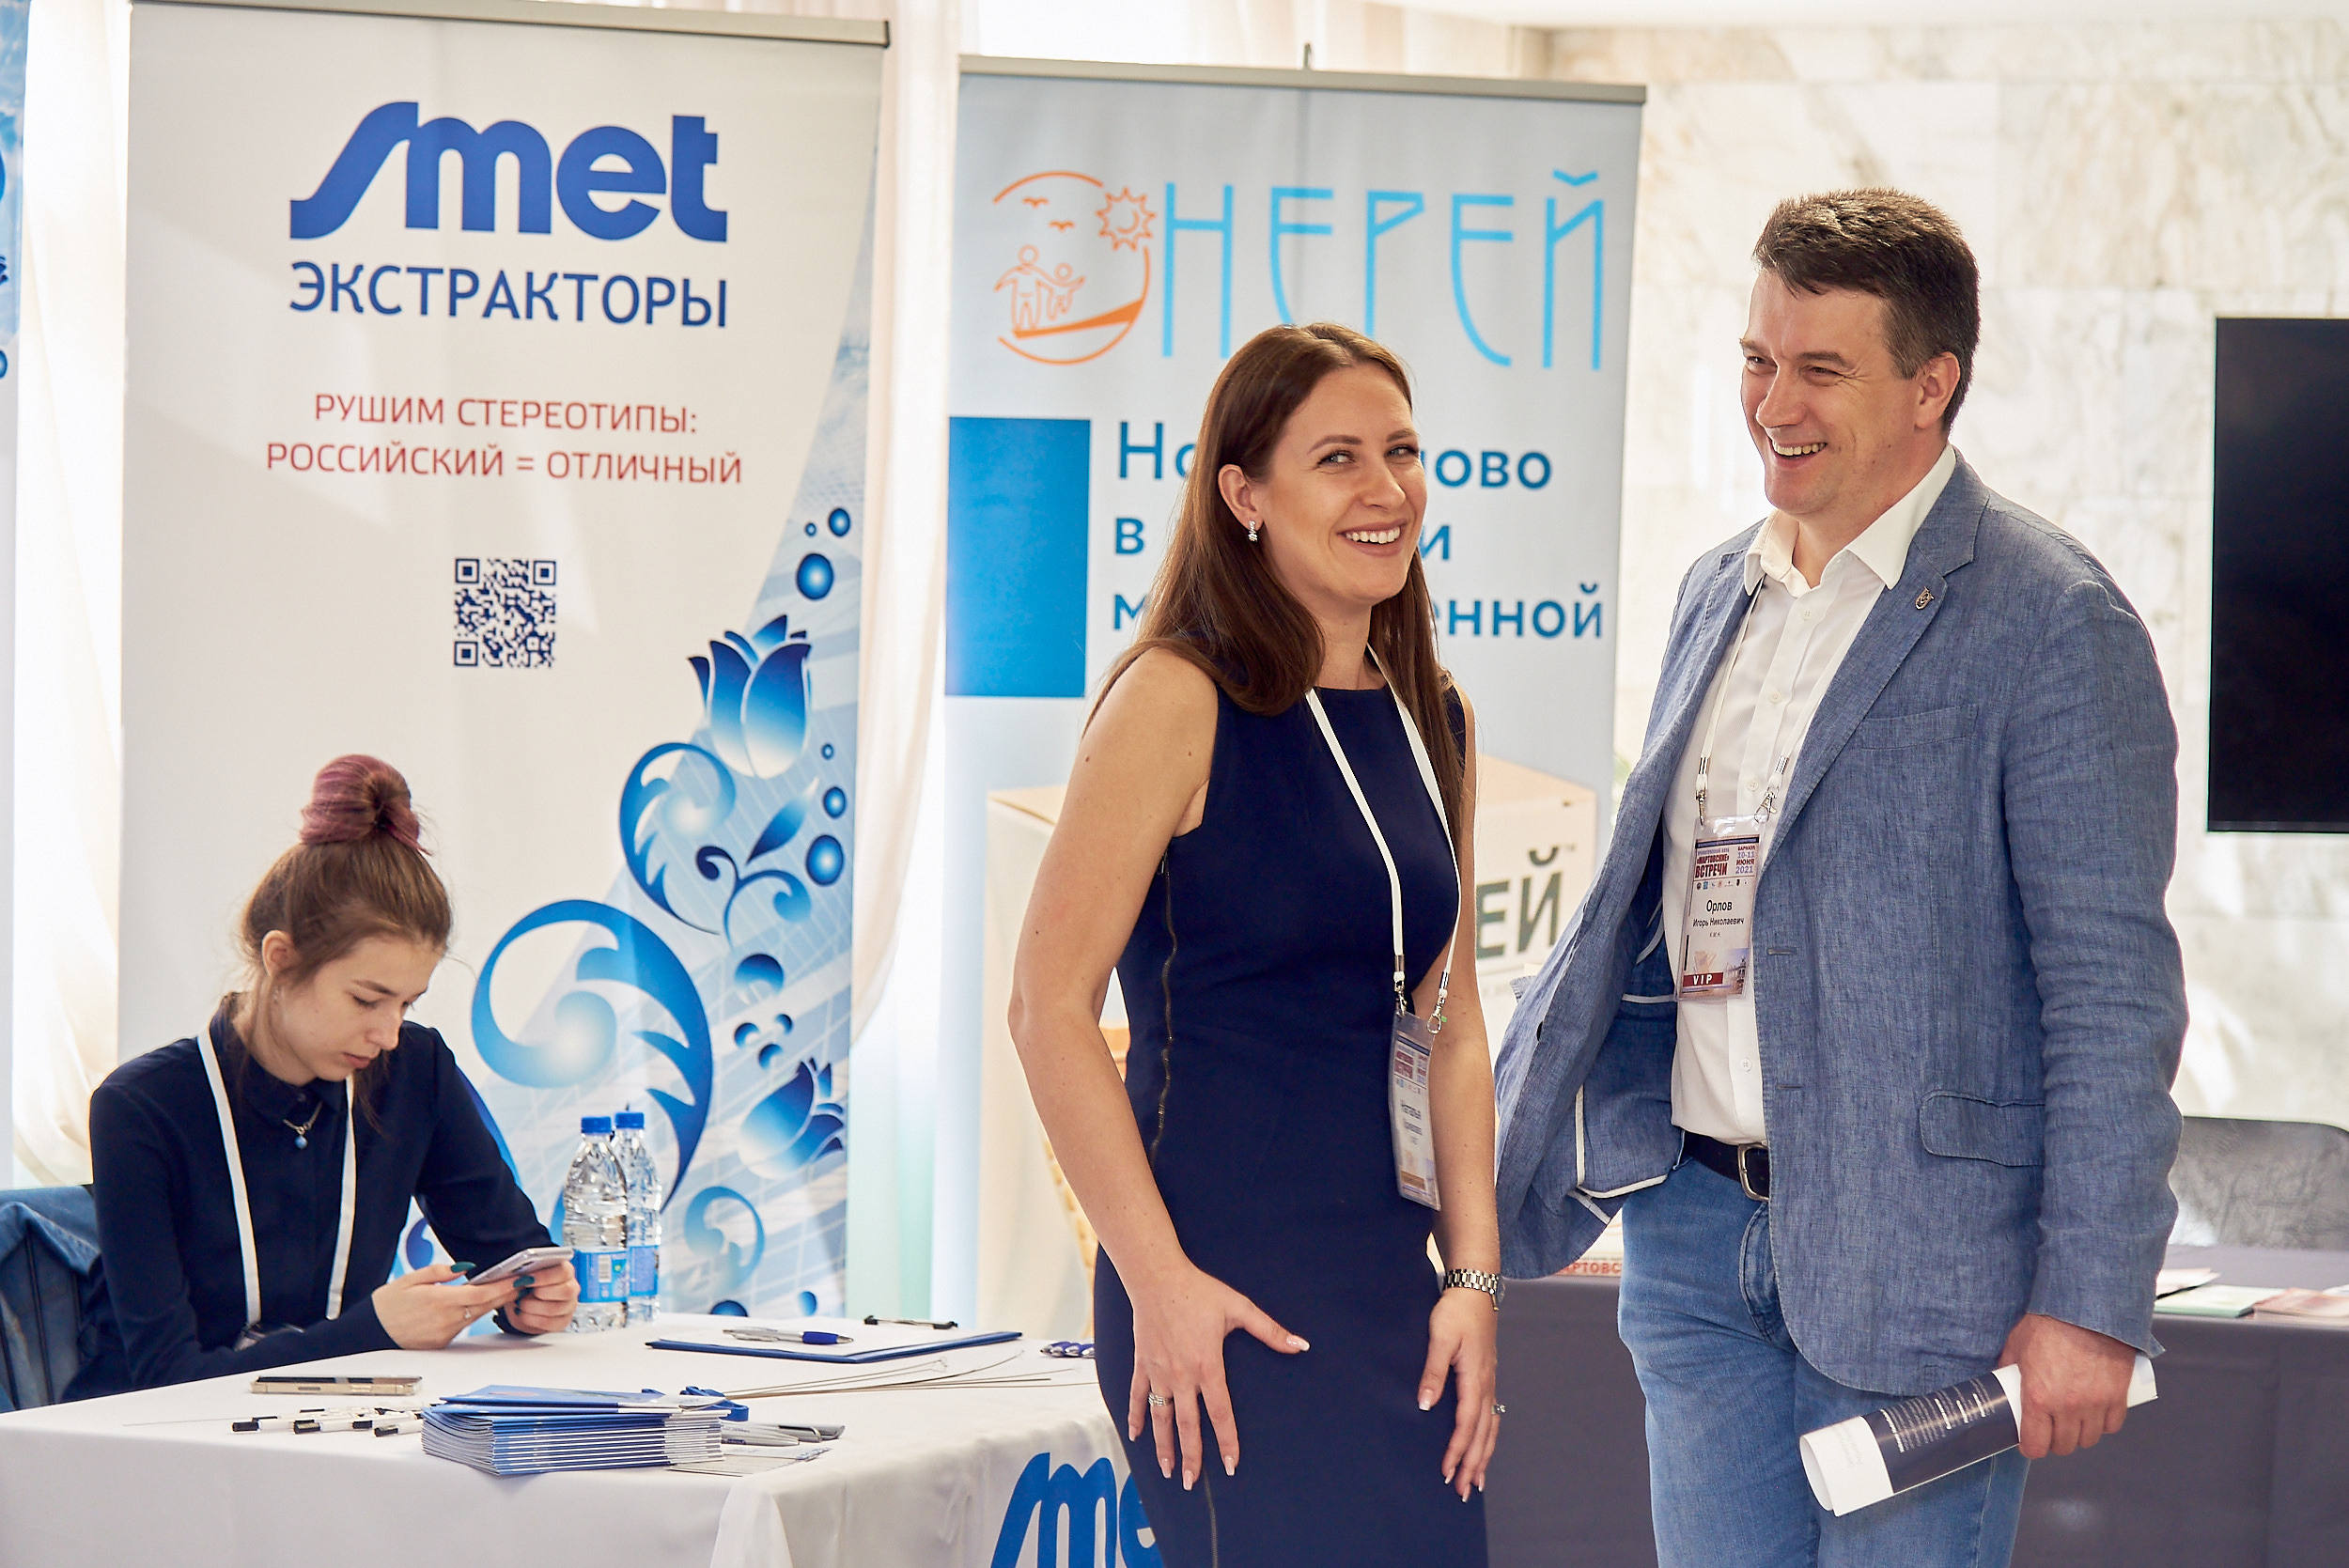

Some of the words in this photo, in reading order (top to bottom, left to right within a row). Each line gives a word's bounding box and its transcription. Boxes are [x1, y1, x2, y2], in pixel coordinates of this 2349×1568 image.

[290, 261, 728, 329] ЭКСТРАКТОРЫ
[315, 393, 445, 426] РУШИМ
[456, 398, 697, 435] СТЕРЕОТИПЫ:
[266, 441, 505, 477] РОССИЙСКИЙ
[547, 450, 742, 485] ОТЛИЧНЫЙ
[1737, 850, 1755, 859] 10-11
[1695, 863, 1728, 878] ВСТРЕЧИ
[1735, 865, 1753, 874] 2021
[1706, 900, 1733, 914] Орлов
[1693, 919, 1708, 928] Игорь
[1710, 918, 1745, 926] Николаевич
[1693, 974, 1713, 986] VIP
